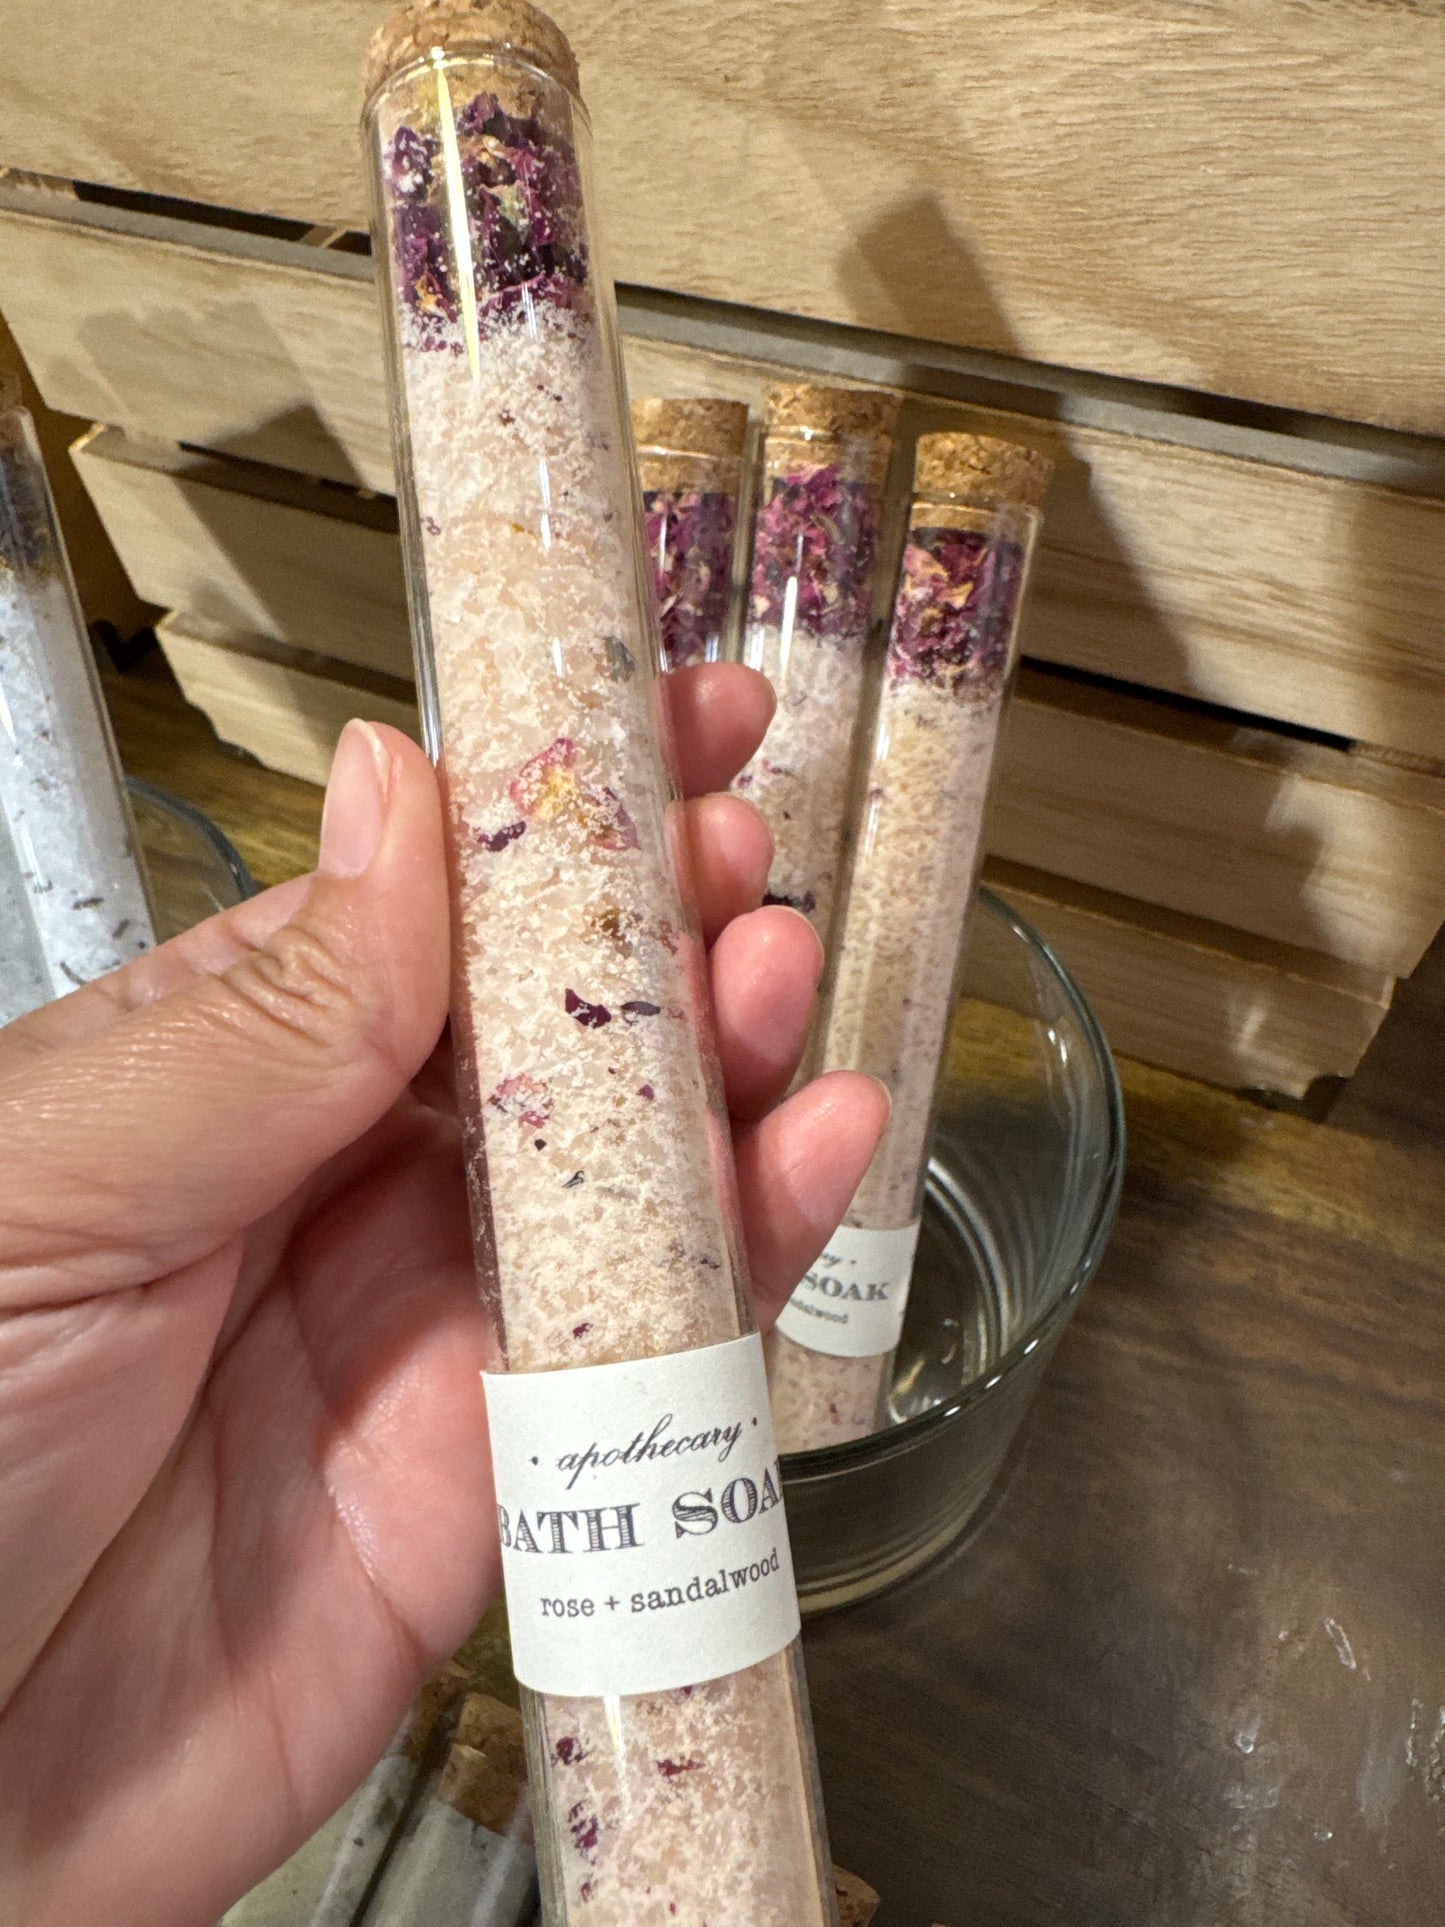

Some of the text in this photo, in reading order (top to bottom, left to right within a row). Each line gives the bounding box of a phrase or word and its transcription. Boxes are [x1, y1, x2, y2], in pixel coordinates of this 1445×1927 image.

[556, 1413, 742, 1490] apothecary
[540, 1547, 781, 1618] rose + sandalwood
